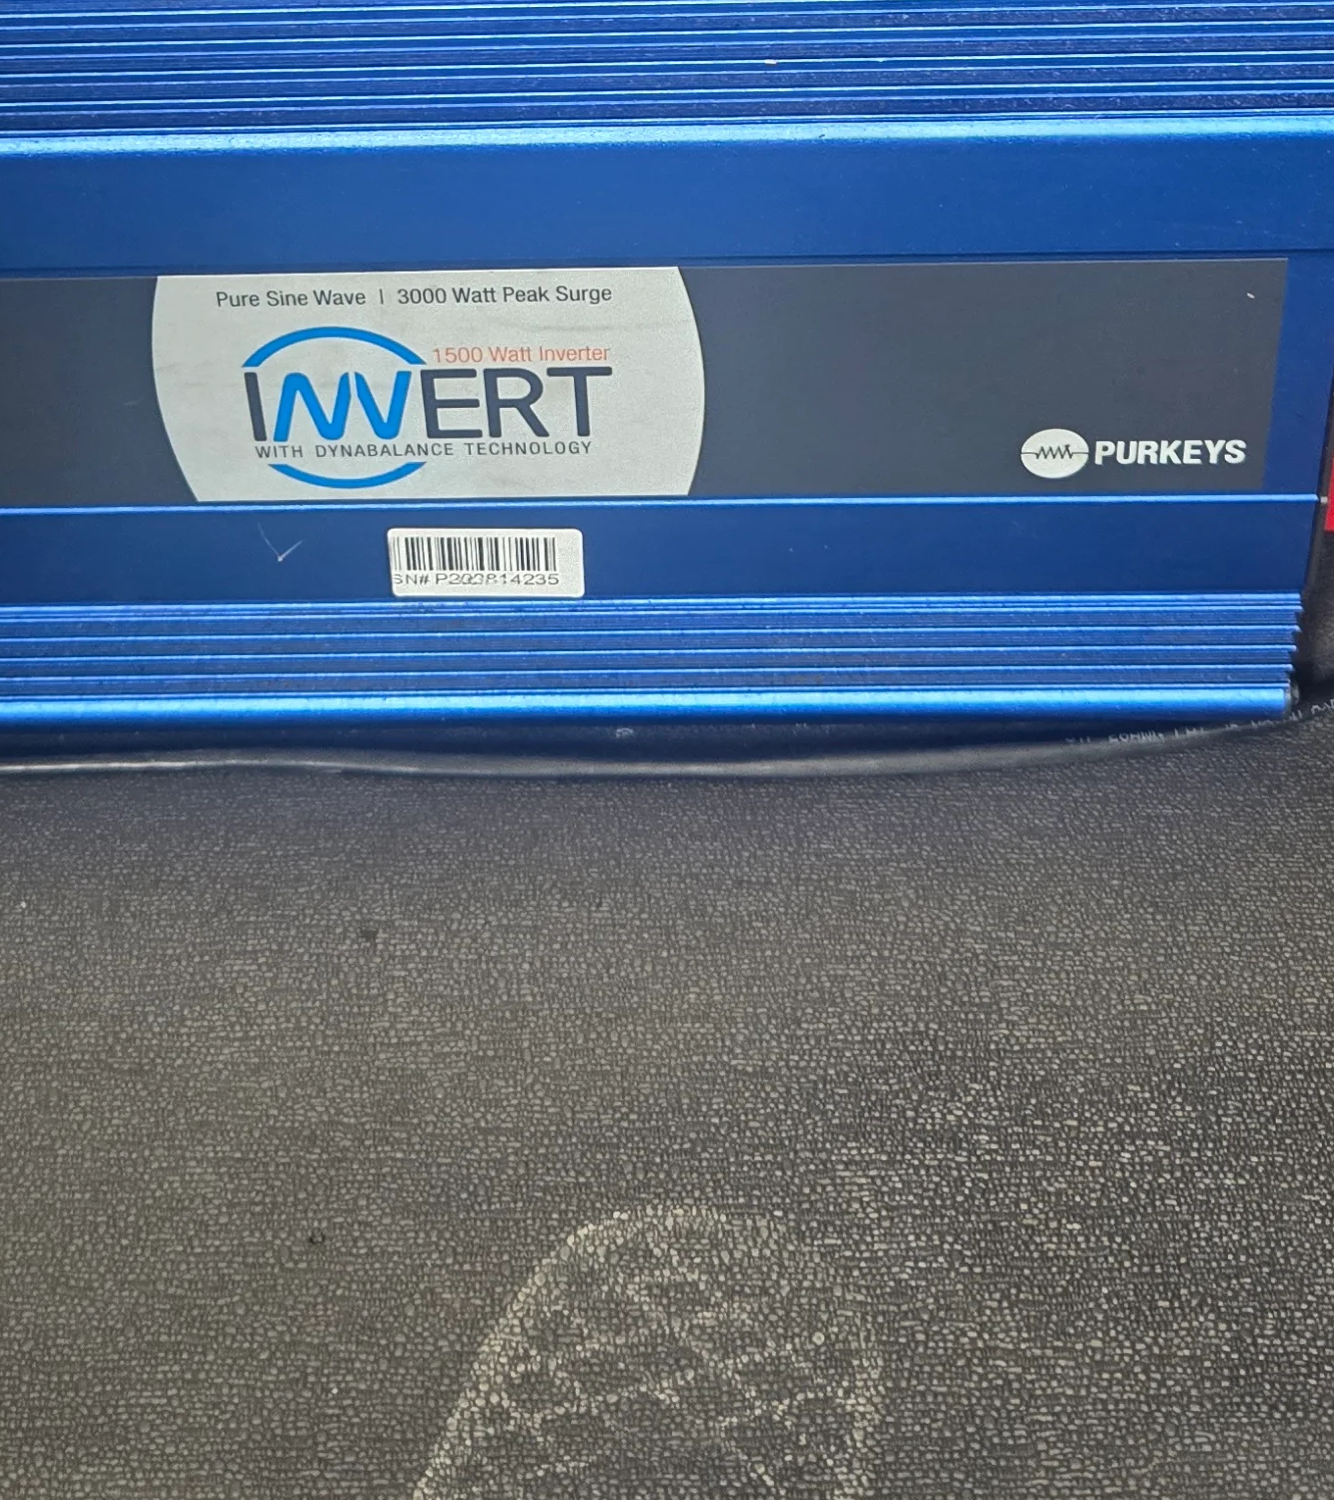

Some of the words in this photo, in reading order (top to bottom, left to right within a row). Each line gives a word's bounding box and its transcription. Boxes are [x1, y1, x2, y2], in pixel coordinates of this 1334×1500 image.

[216, 291, 260, 307] Pure
[267, 290, 308, 307] Sine
[313, 289, 366, 306] Wave
[397, 288, 447, 304] 3000
[451, 287, 496, 303] Watt
[503, 286, 549, 302] Peak
[555, 285, 612, 304] Surge
[432, 347, 483, 363] 1500
[488, 346, 532, 362] Watt
[539, 345, 611, 361] Inverter
[244, 366, 613, 442] INVERT
[255, 445, 303, 459] WITH
[316, 443, 454, 458] DYNABALANCE
[464, 441, 592, 456] TECHNOLOGY
[1094, 439, 1247, 465] PURKEYS
[393, 574, 429, 585] SN#
